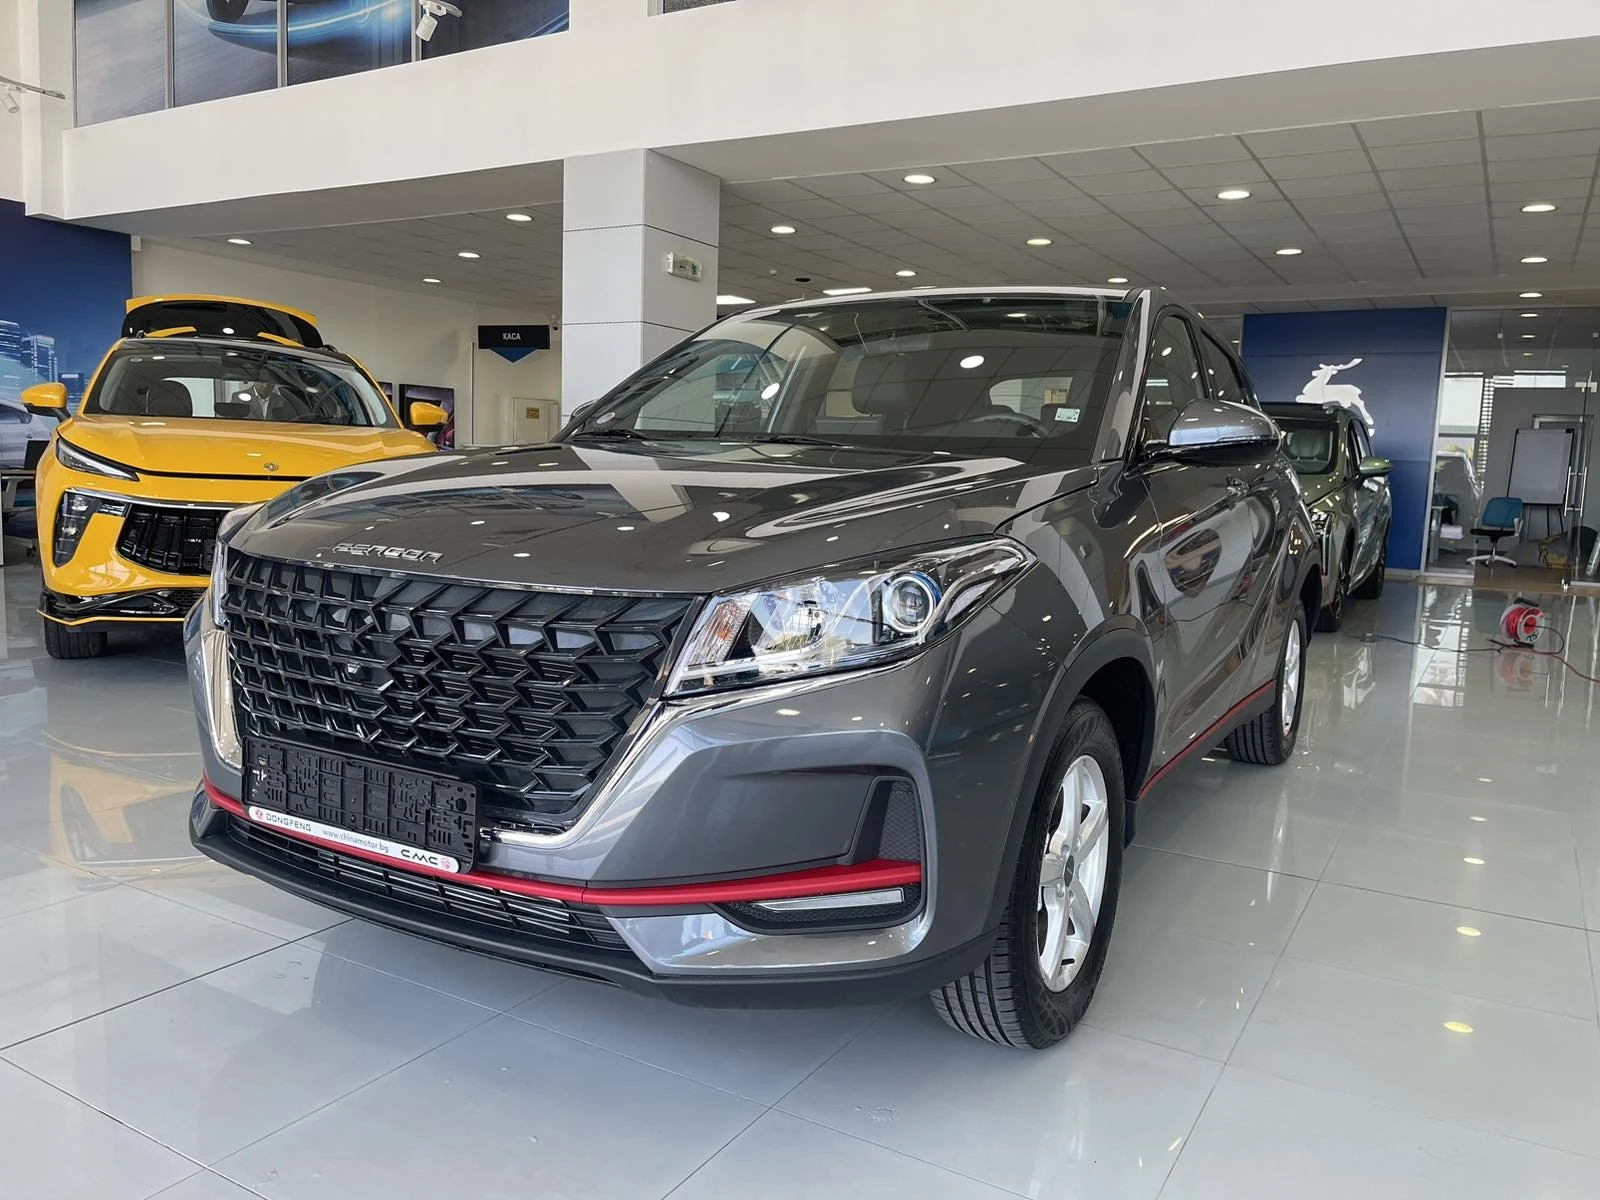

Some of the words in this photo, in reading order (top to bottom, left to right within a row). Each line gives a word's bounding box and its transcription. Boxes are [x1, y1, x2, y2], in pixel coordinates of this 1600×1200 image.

[502, 332, 521, 341] КАСА
[265, 812, 312, 832] DONGFENG
[322, 828, 389, 853] www.chinamotor.bg
[400, 849, 438, 866] CMC
